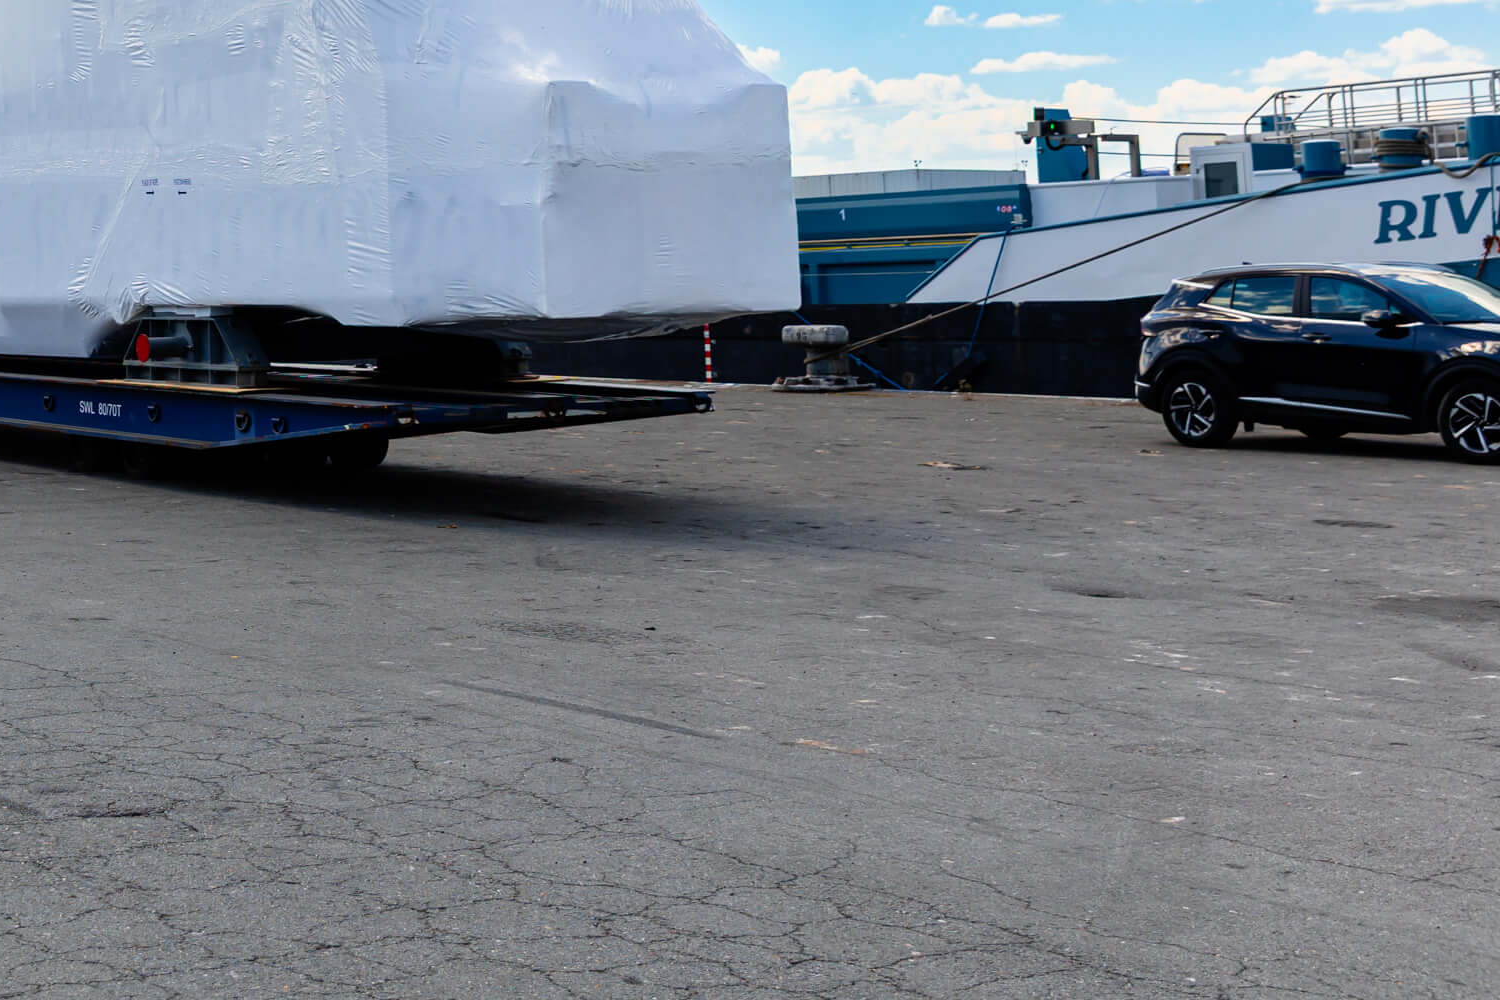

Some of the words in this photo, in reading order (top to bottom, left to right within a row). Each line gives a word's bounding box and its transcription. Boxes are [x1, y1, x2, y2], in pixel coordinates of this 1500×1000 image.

[1373, 186, 1500, 244] RIV
[79, 400, 96, 415] SWL
[98, 402, 122, 417] 80/70T
